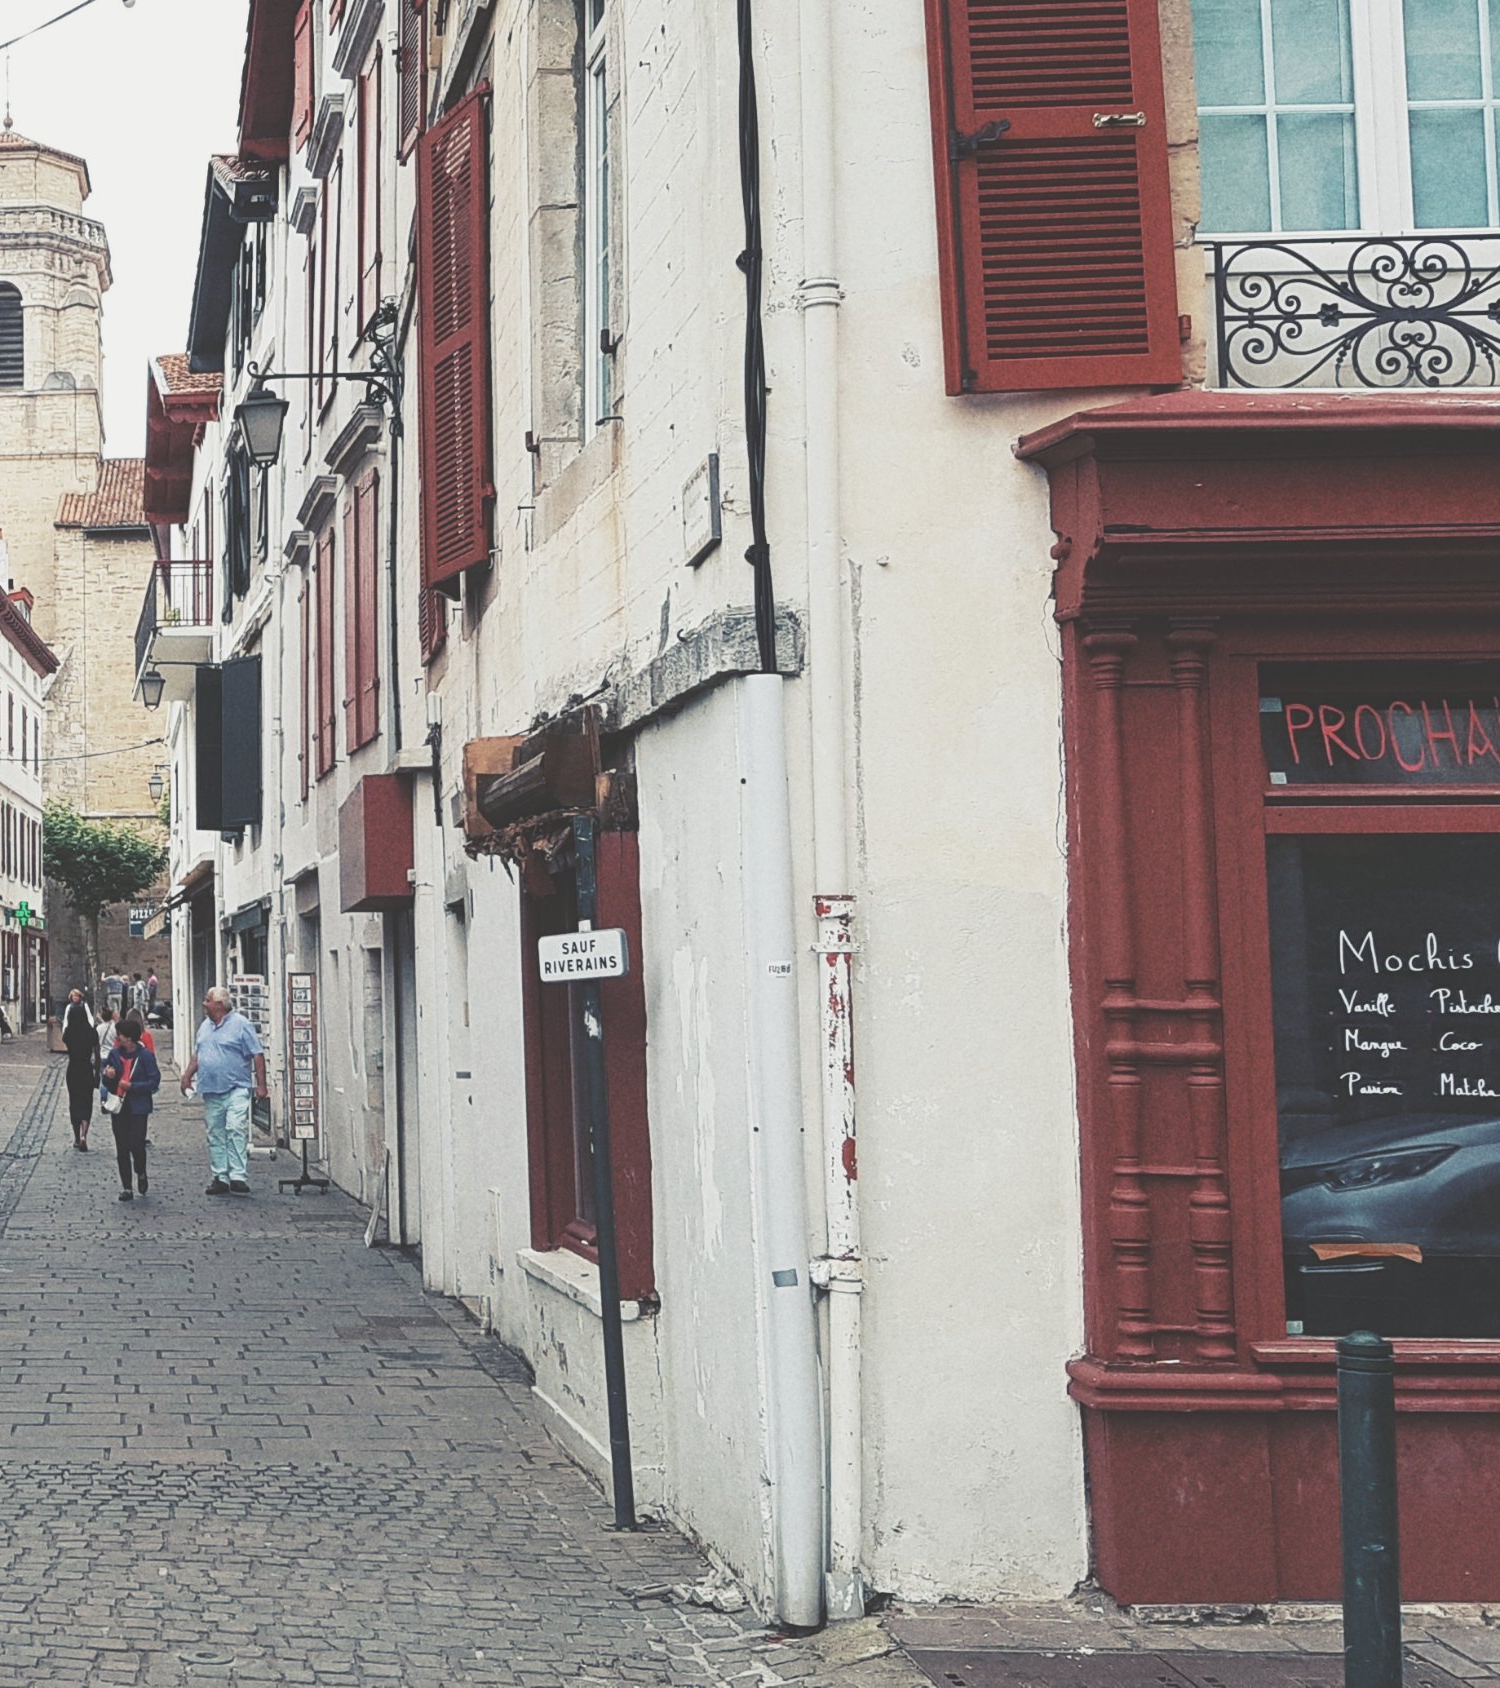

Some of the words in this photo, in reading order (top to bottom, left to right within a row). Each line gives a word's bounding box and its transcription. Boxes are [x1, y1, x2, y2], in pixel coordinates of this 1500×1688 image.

[1286, 696, 1500, 772] PROCHA
[561, 939, 596, 955] SAUF
[1339, 929, 1474, 975] Mochis
[544, 955, 617, 974] RIVERAINS
[1338, 988, 1397, 1018] Vanille
[1429, 988, 1500, 1014] Pistache
[1345, 1028, 1408, 1058] Mangue
[1439, 1032, 1484, 1051] Coco
[1339, 1071, 1403, 1096] Passion
[1440, 1072, 1500, 1097] Matcha
